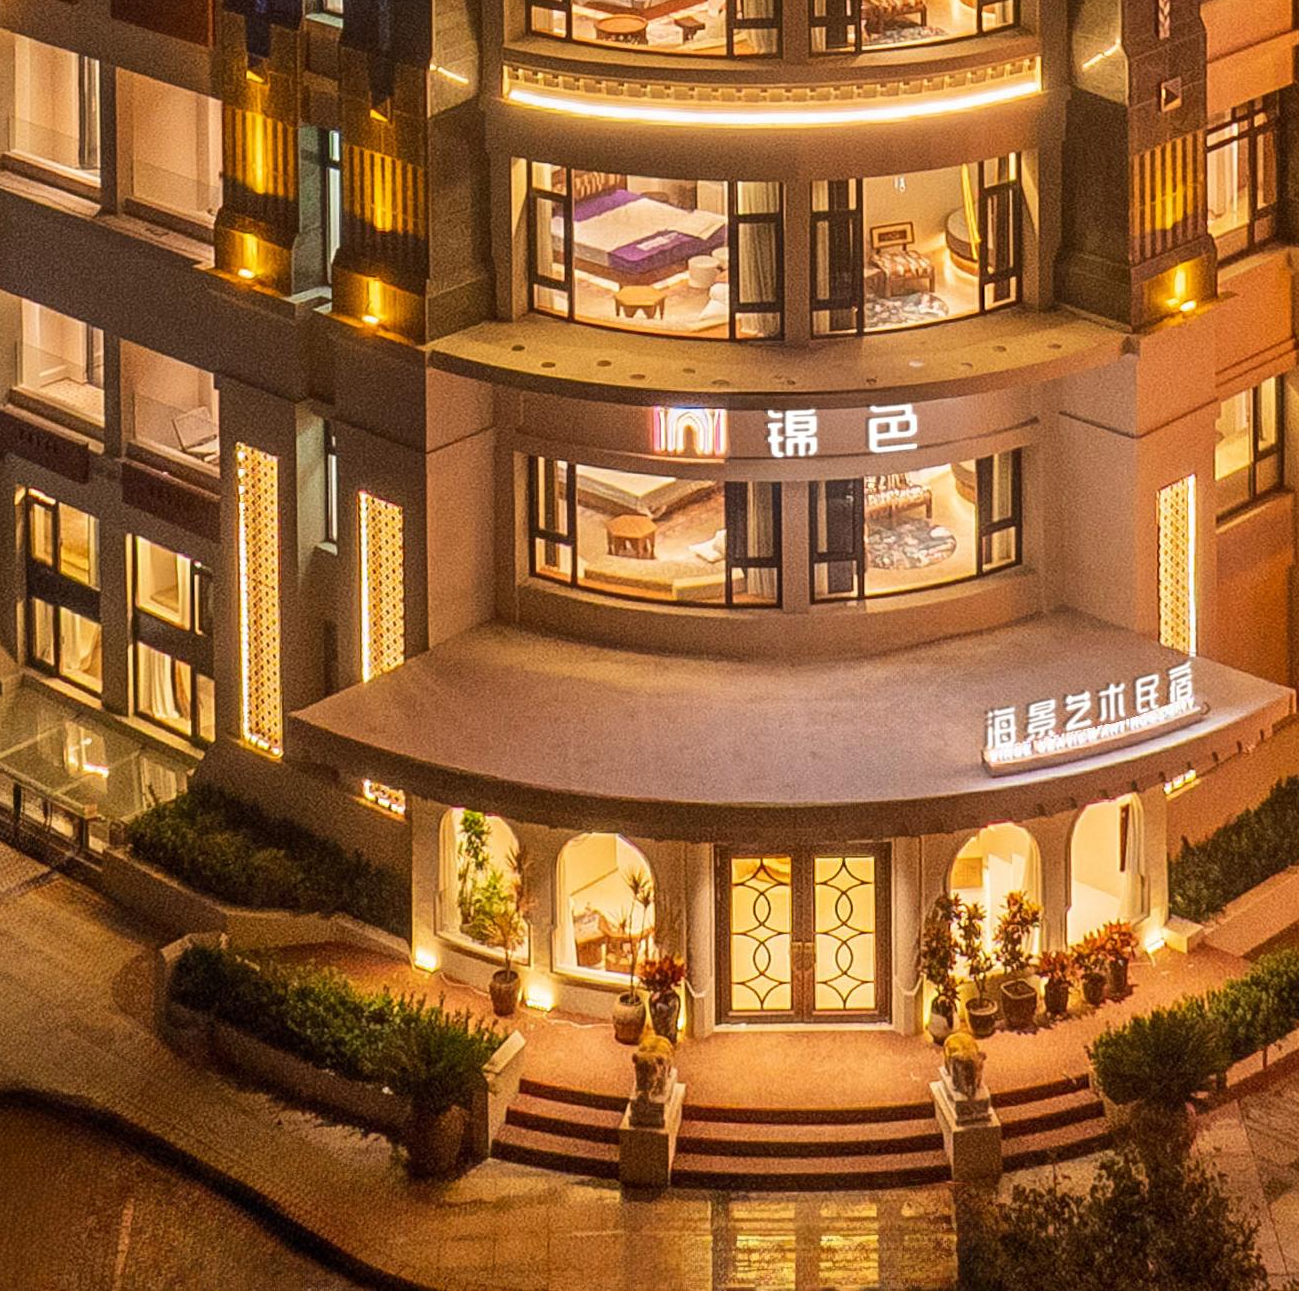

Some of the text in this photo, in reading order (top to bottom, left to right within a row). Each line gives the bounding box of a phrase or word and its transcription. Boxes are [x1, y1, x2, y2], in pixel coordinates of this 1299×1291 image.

[767, 403, 919, 458] 锦色
[985, 661, 1194, 750] 海景艺术民宿
